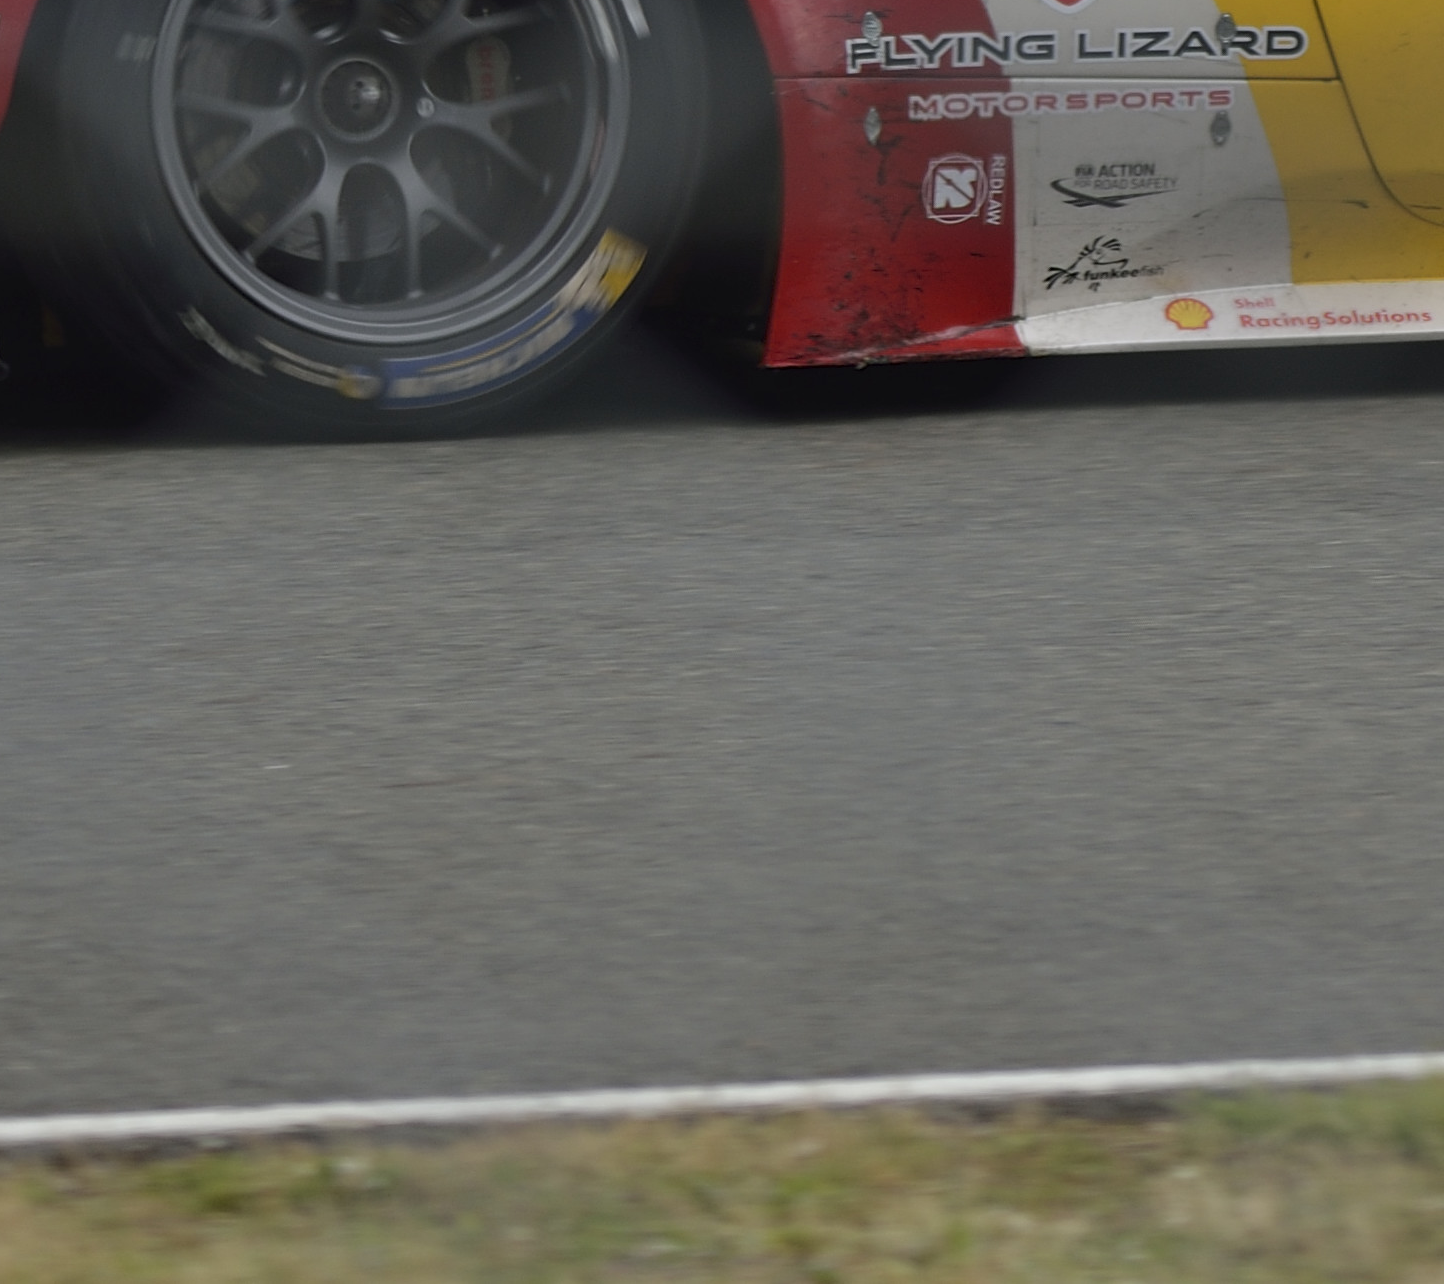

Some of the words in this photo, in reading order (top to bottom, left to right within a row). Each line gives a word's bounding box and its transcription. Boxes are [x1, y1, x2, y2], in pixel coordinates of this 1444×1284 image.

[846, 32, 1055, 74] FLYING
[1077, 27, 1306, 60] LIZARD
[909, 88, 1234, 121] MOTORSPORTS
[1098, 163, 1156, 177] ACTION
[986, 155, 1006, 226] REDLAW
[1094, 178, 1129, 189] ROAD
[1131, 177, 1177, 189] SAFETY
[1233, 297, 1276, 309] Shell
